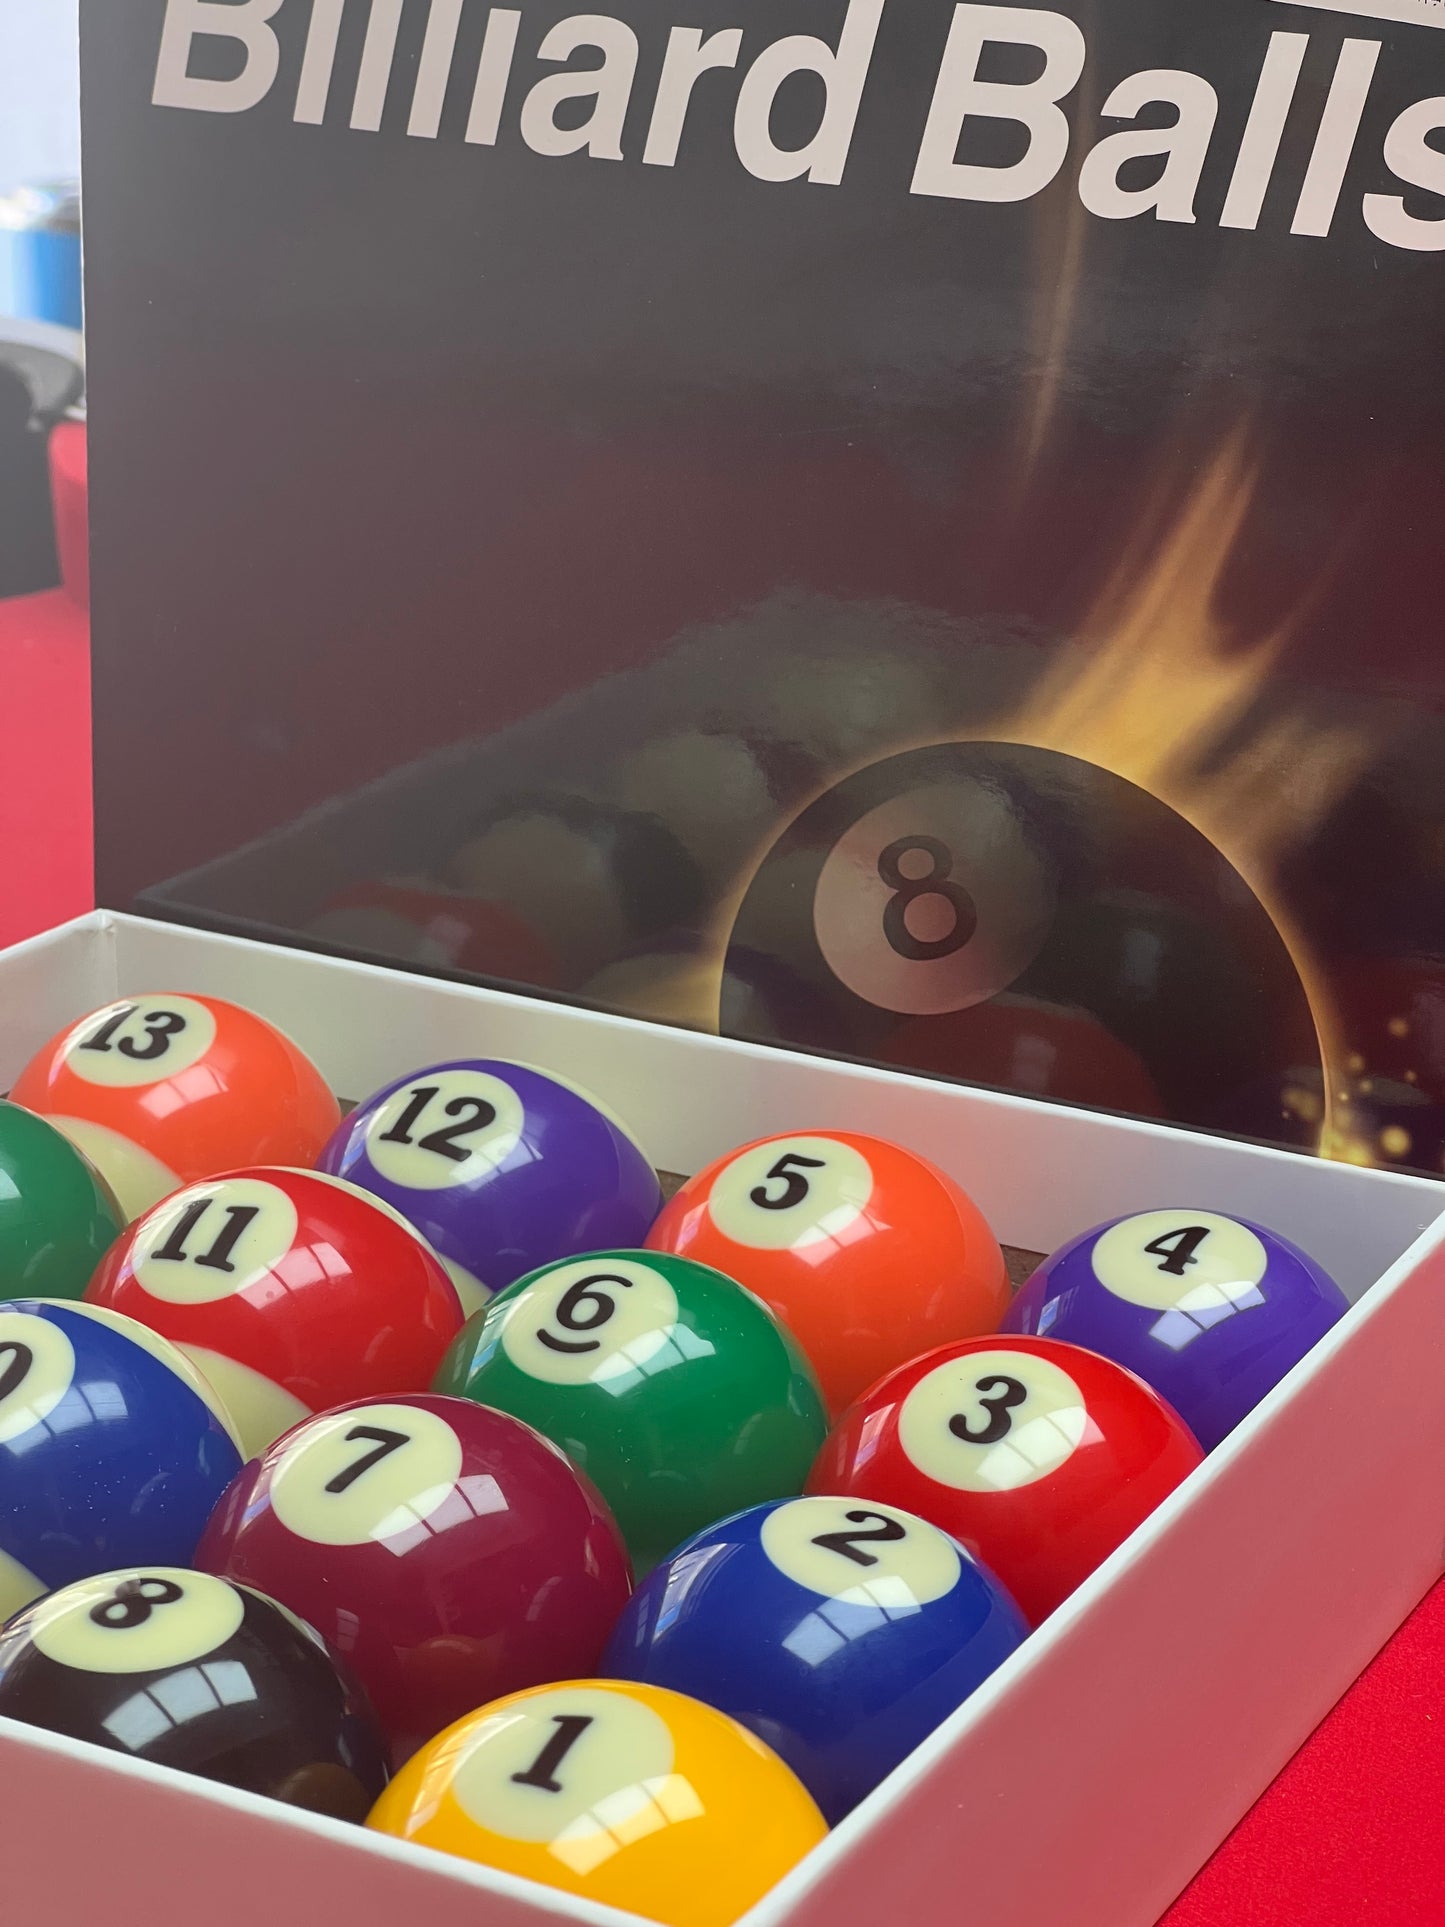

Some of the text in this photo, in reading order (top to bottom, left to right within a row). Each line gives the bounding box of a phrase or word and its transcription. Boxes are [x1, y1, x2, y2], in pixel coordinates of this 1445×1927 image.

[152, 0, 1445, 252] Billiard Balls
[877, 835, 977, 961] 8
[79, 1005, 187, 1060] 13
[379, 1086, 496, 1162] 12
[750, 1153, 826, 1210] 5
[151, 1198, 259, 1272] 11
[1144, 1225, 1211, 1276] 4
[536, 1274, 633, 1354] 6
[948, 1375, 1027, 1444] 3
[325, 1426, 410, 1493] 7
[811, 1509, 907, 1567] 2
[89, 1577, 184, 1629] 8
[511, 1715, 593, 1792] 1
